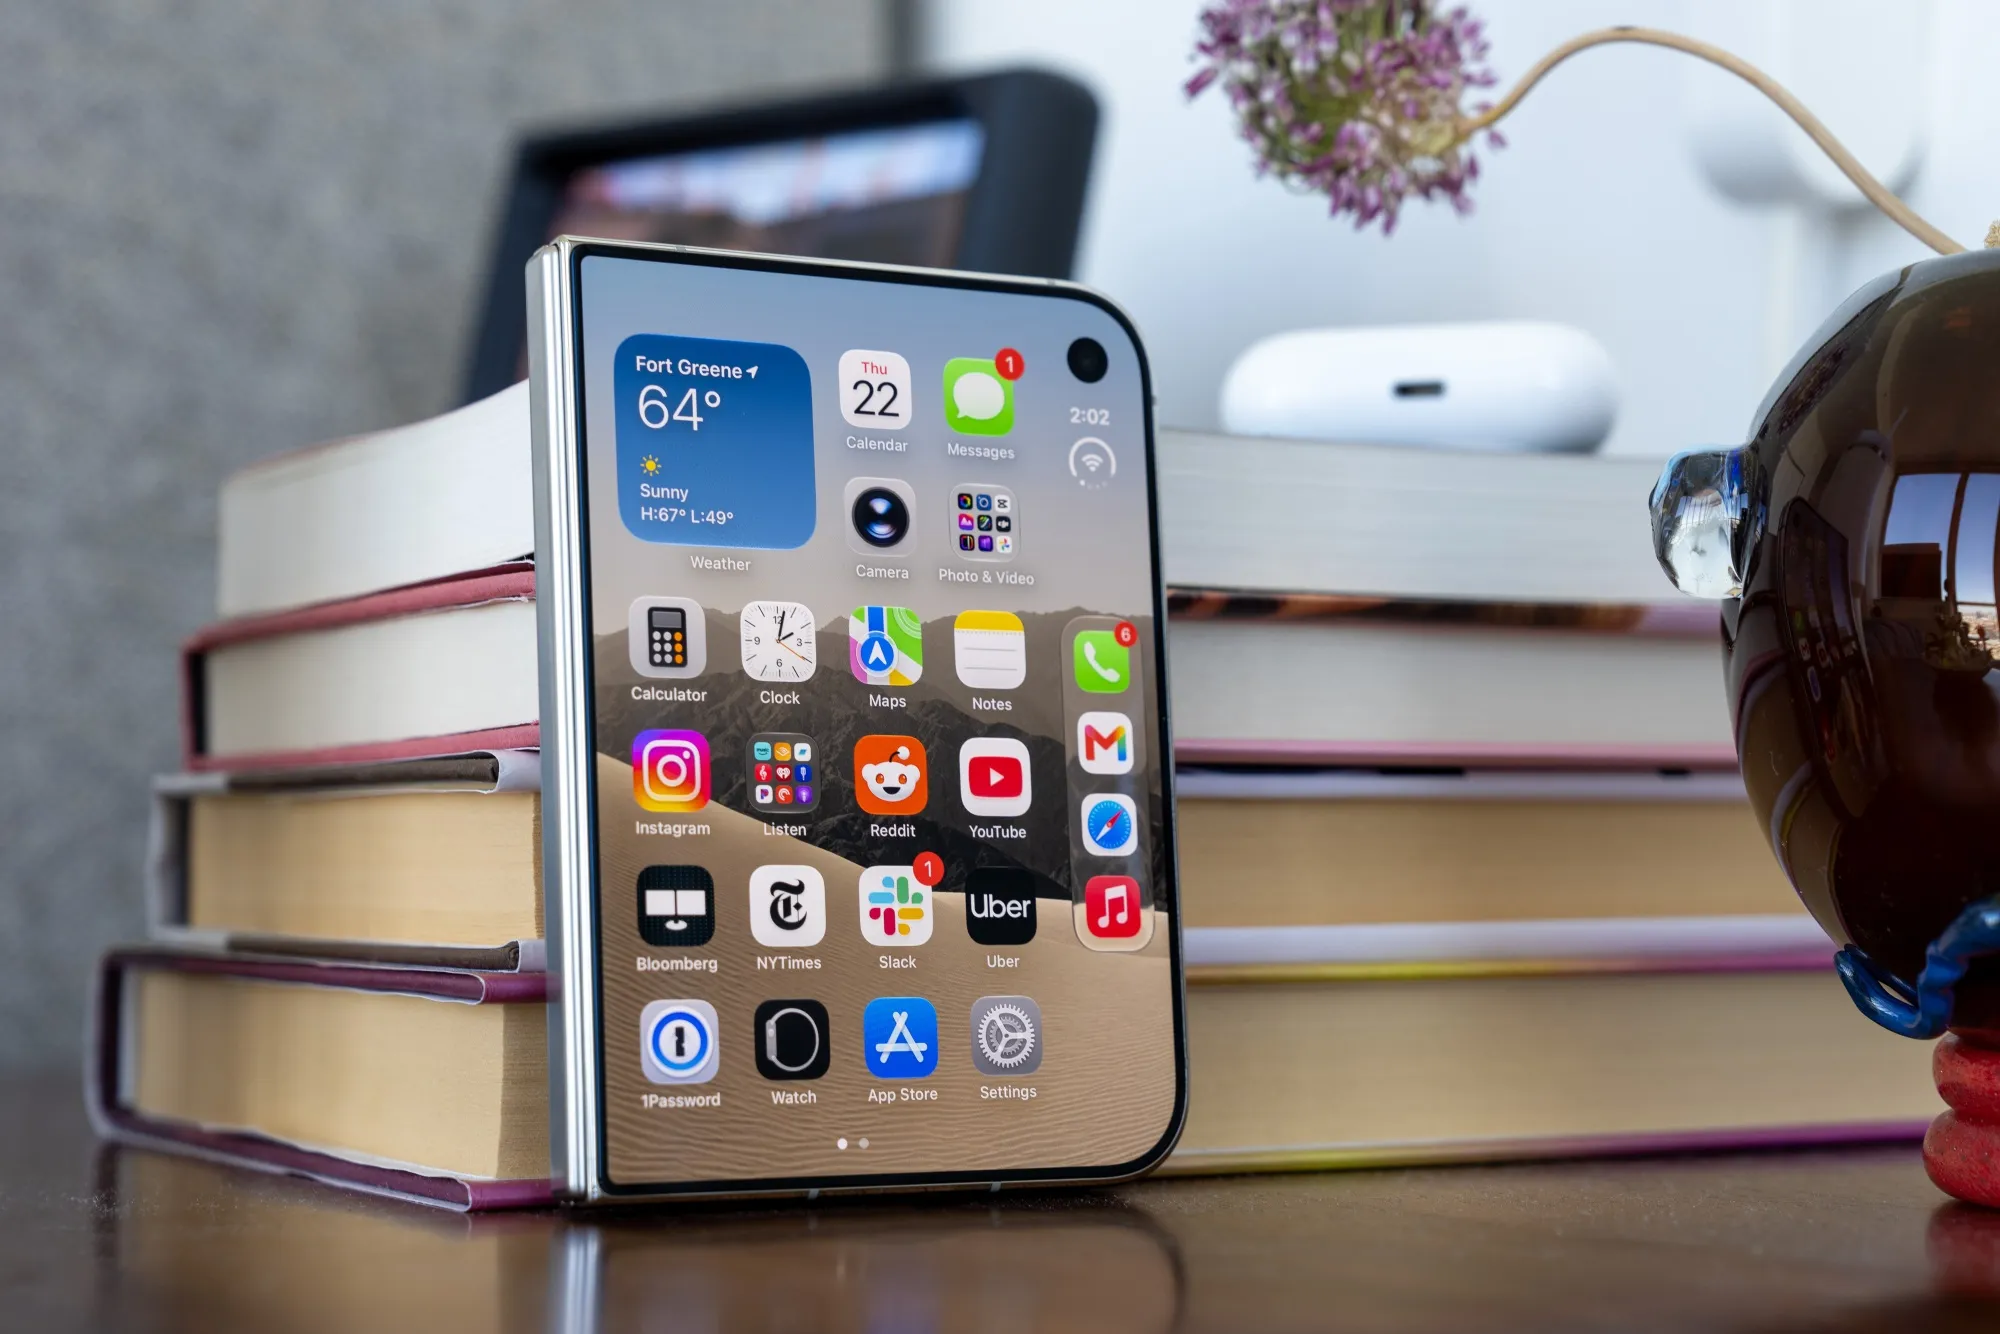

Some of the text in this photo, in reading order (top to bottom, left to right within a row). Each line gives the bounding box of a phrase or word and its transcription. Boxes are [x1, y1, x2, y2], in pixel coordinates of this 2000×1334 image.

[635, 354, 743, 379] Fort Greene
[861, 360, 888, 375] Thu
[1004, 355, 1014, 373] 1
[852, 379, 900, 418] 22
[637, 383, 721, 431] 64°
[1069, 406, 1110, 426] 2:02
[846, 436, 909, 453] Calendar
[947, 442, 1015, 460] Messages
[639, 483, 689, 503] Sunny
[640, 506, 734, 525] H:67° L:49°
[690, 555, 752, 571] Weather
[856, 564, 909, 580] Camera
[938, 568, 1035, 586] Photo & Video
[753, 636, 761, 645] 9
[796, 637, 803, 647] 3
[1120, 627, 1131, 642] 6
[776, 658, 783, 668] 6
[631, 686, 708, 702] Calculator
[760, 690, 801, 705] Clock
[869, 693, 907, 710] Maps
[972, 697, 1013, 711] Notes
[635, 820, 711, 837] Instagram
[763, 822, 807, 837] Listen
[870, 823, 916, 838] Reddit
[969, 824, 1027, 839] YouTube
[924, 860, 932, 878] 1
[970, 893, 1032, 919] Uber
[636, 956, 718, 974] Bloomberg
[756, 955, 822, 971] NYTimes
[878, 955, 917, 970] Slack
[986, 954, 1020, 969] Uber
[640, 1092, 721, 1109] 1Password
[771, 1089, 817, 1105] Watch
[868, 1087, 938, 1104] App Store
[980, 1085, 1037, 1101] Settings
